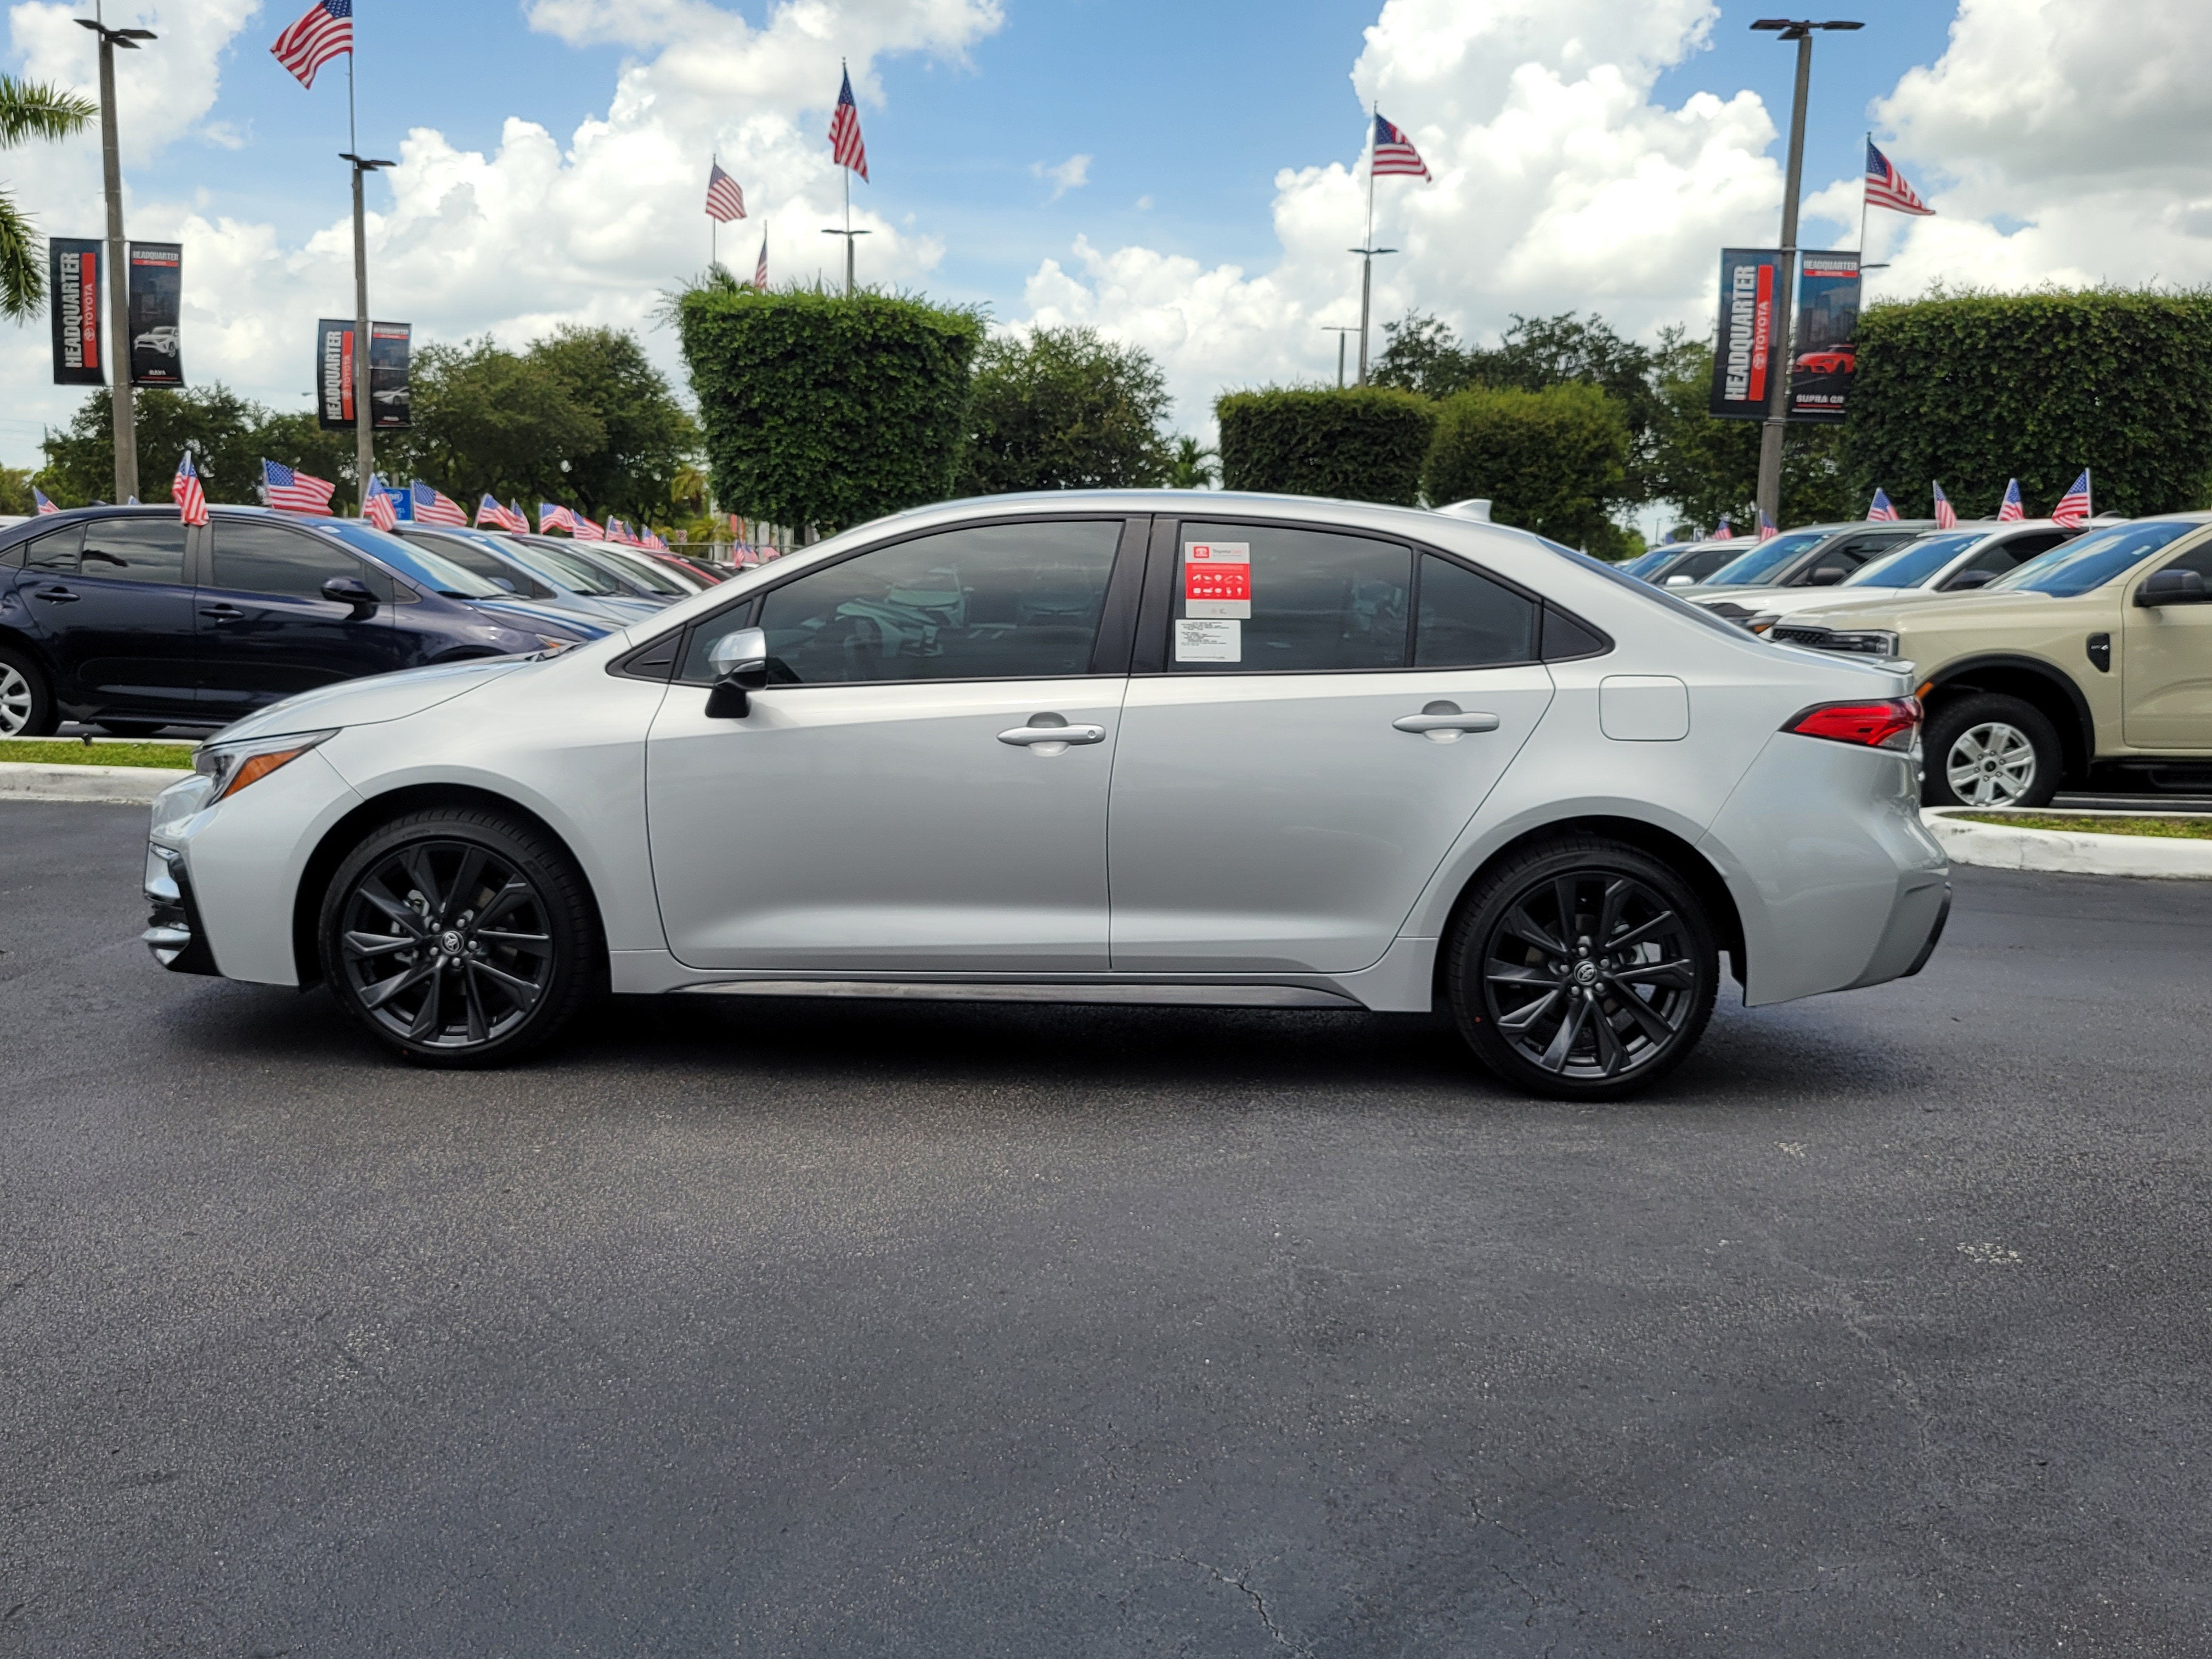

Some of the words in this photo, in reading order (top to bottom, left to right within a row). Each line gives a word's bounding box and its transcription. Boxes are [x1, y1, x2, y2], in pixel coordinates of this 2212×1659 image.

[60, 252, 82, 368] HEADQUARTER
[84, 284, 94, 329] TOYOTA
[1724, 265, 1756, 400] HEADQUARTER
[1755, 301, 1769, 351] TOYOTA
[324, 330, 342, 420] HEADQUARTER
[1796, 394, 1829, 403] SUPRA
